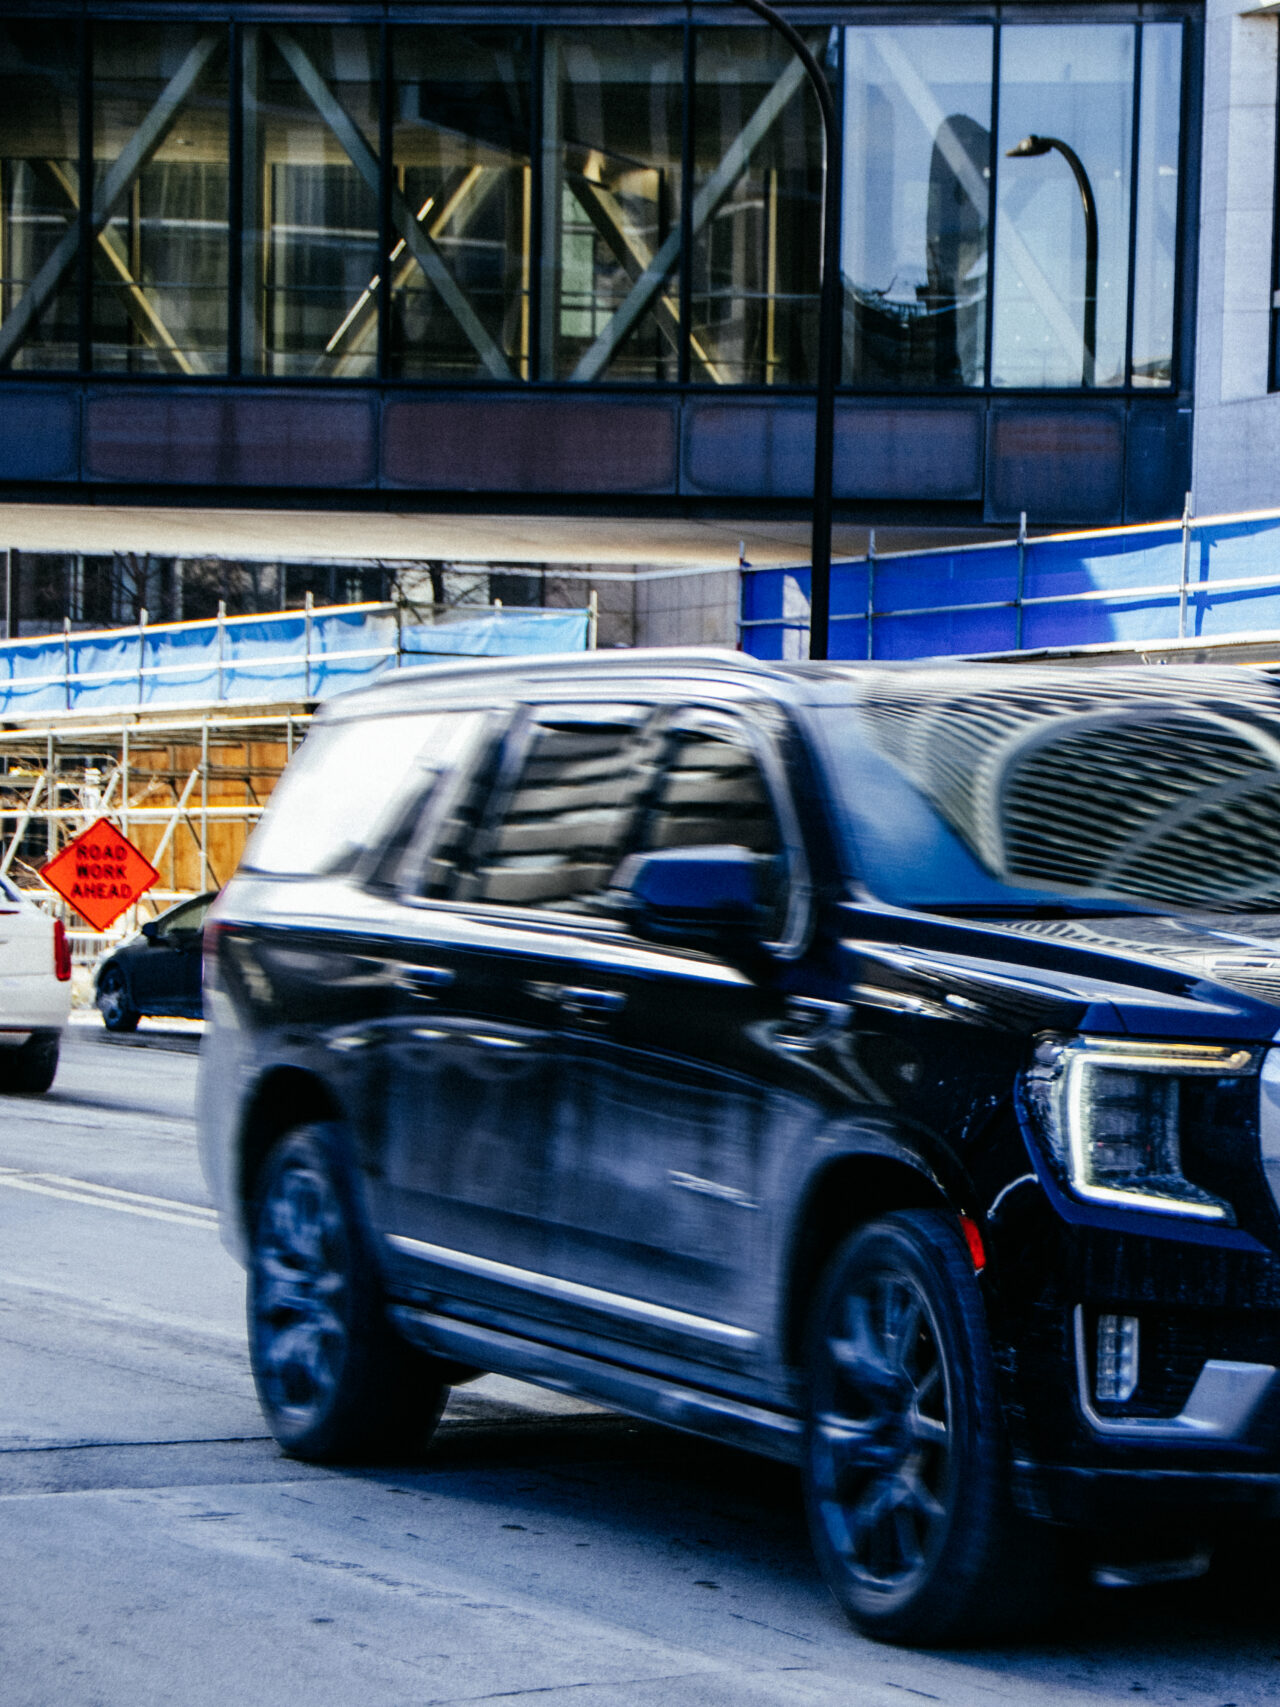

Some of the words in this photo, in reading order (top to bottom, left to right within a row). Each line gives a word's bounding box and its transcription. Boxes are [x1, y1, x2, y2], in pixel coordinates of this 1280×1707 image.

[76, 844, 128, 861] ROAD
[76, 863, 128, 880] WORK
[70, 883, 132, 899] AHEAD
